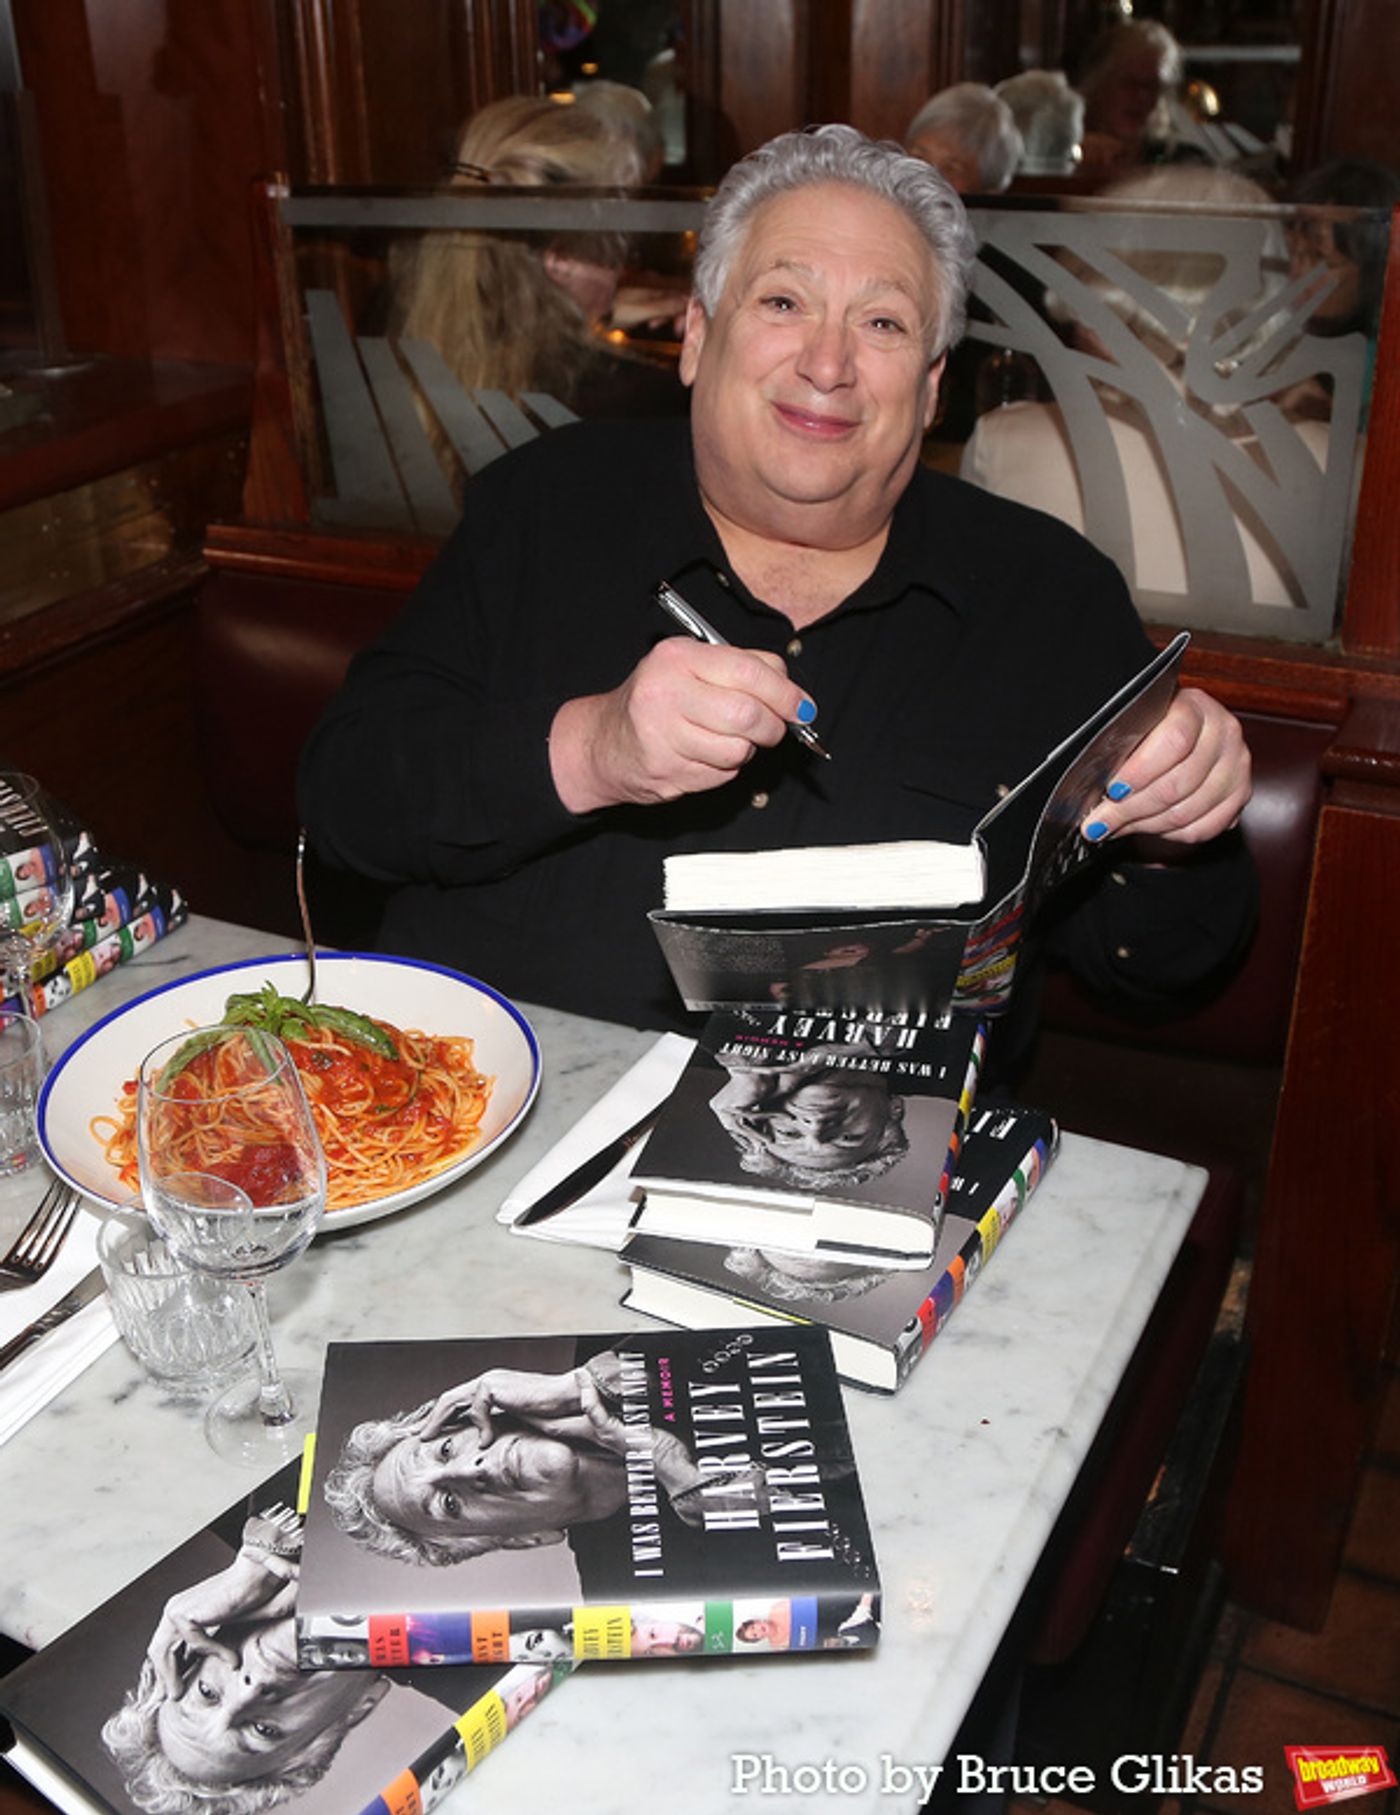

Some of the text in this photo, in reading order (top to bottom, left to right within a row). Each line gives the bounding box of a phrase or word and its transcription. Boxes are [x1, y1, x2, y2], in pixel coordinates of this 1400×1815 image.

[768, 1014, 918, 1049] HARVEY
[720, 1042, 771, 1060] NIGHT
[776, 1049, 819, 1066] LAST
[826, 1054, 892, 1073] BETTER
[897, 1062, 932, 1077] WAS
[658, 1358, 676, 1422] A MEMOIR
[618, 1352, 664, 1577] I WAS BETTER LAST NIGHT
[688, 1381, 761, 1531] HARVEY
[746, 1352, 835, 1562] FIERSTEIN
